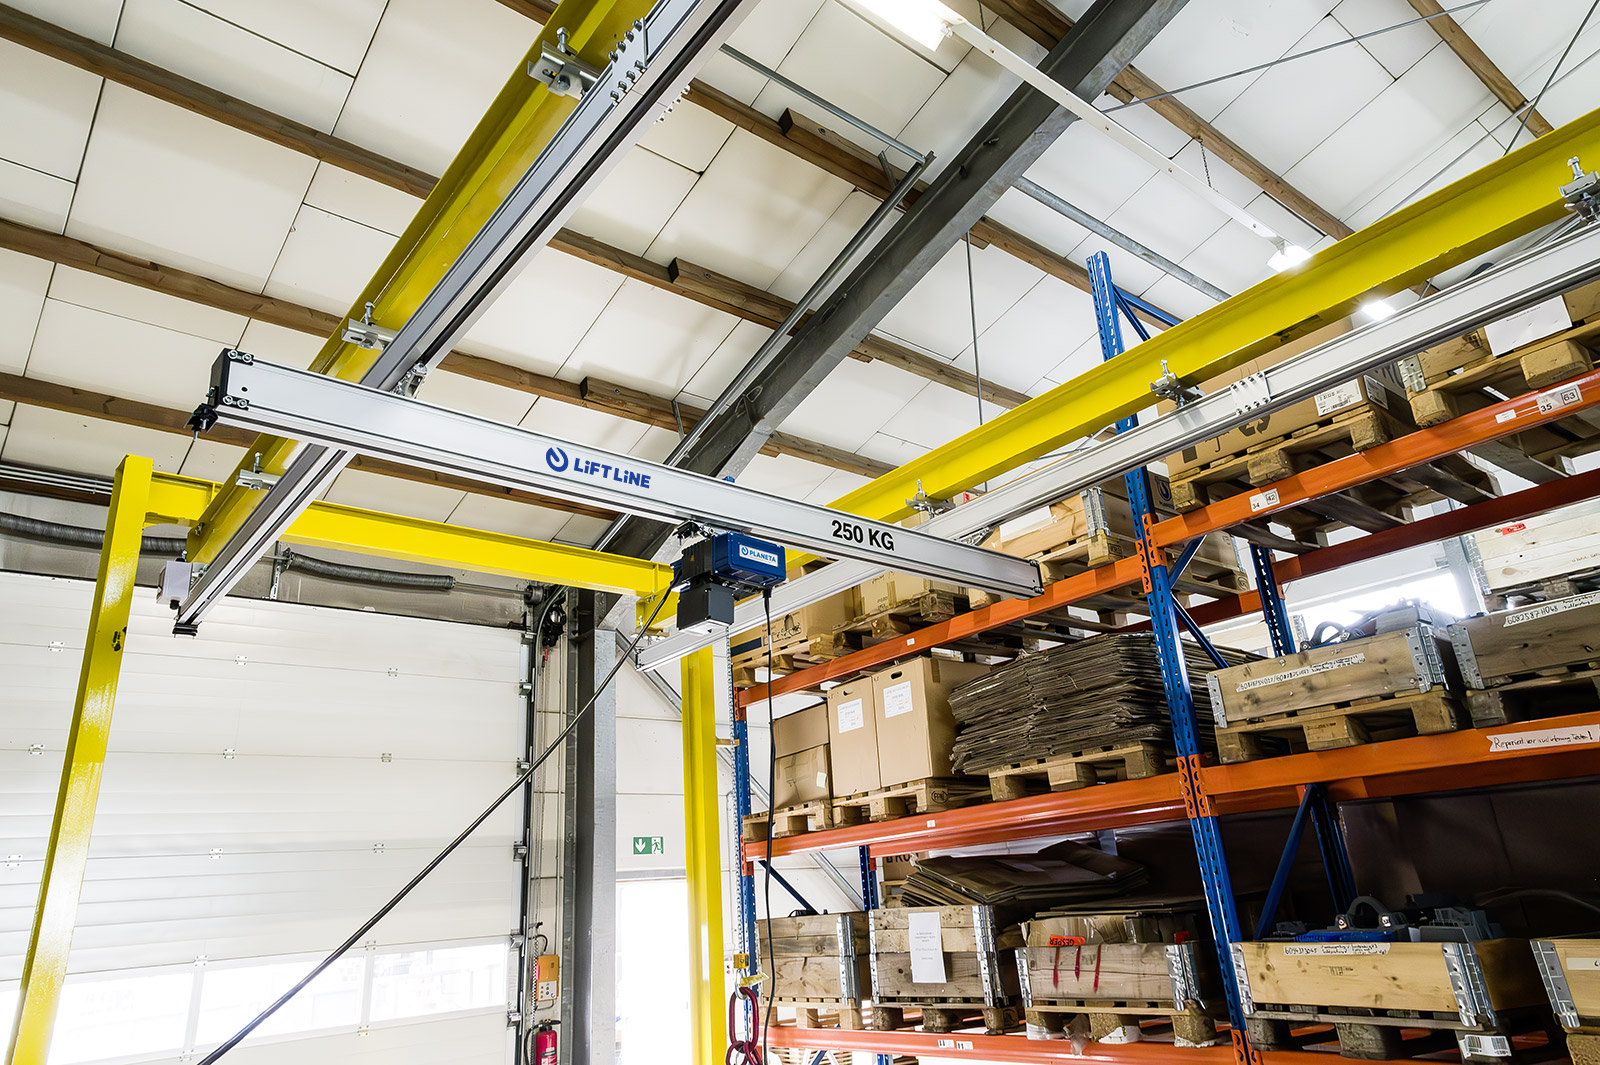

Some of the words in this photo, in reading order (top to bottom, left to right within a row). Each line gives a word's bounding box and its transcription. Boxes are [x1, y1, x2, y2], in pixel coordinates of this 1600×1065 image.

[1563, 391, 1576, 401] 63
[1540, 403, 1553, 413] 35
[831, 519, 863, 543] 250
[868, 527, 895, 551] KG
[749, 549, 777, 563] PLANETA
